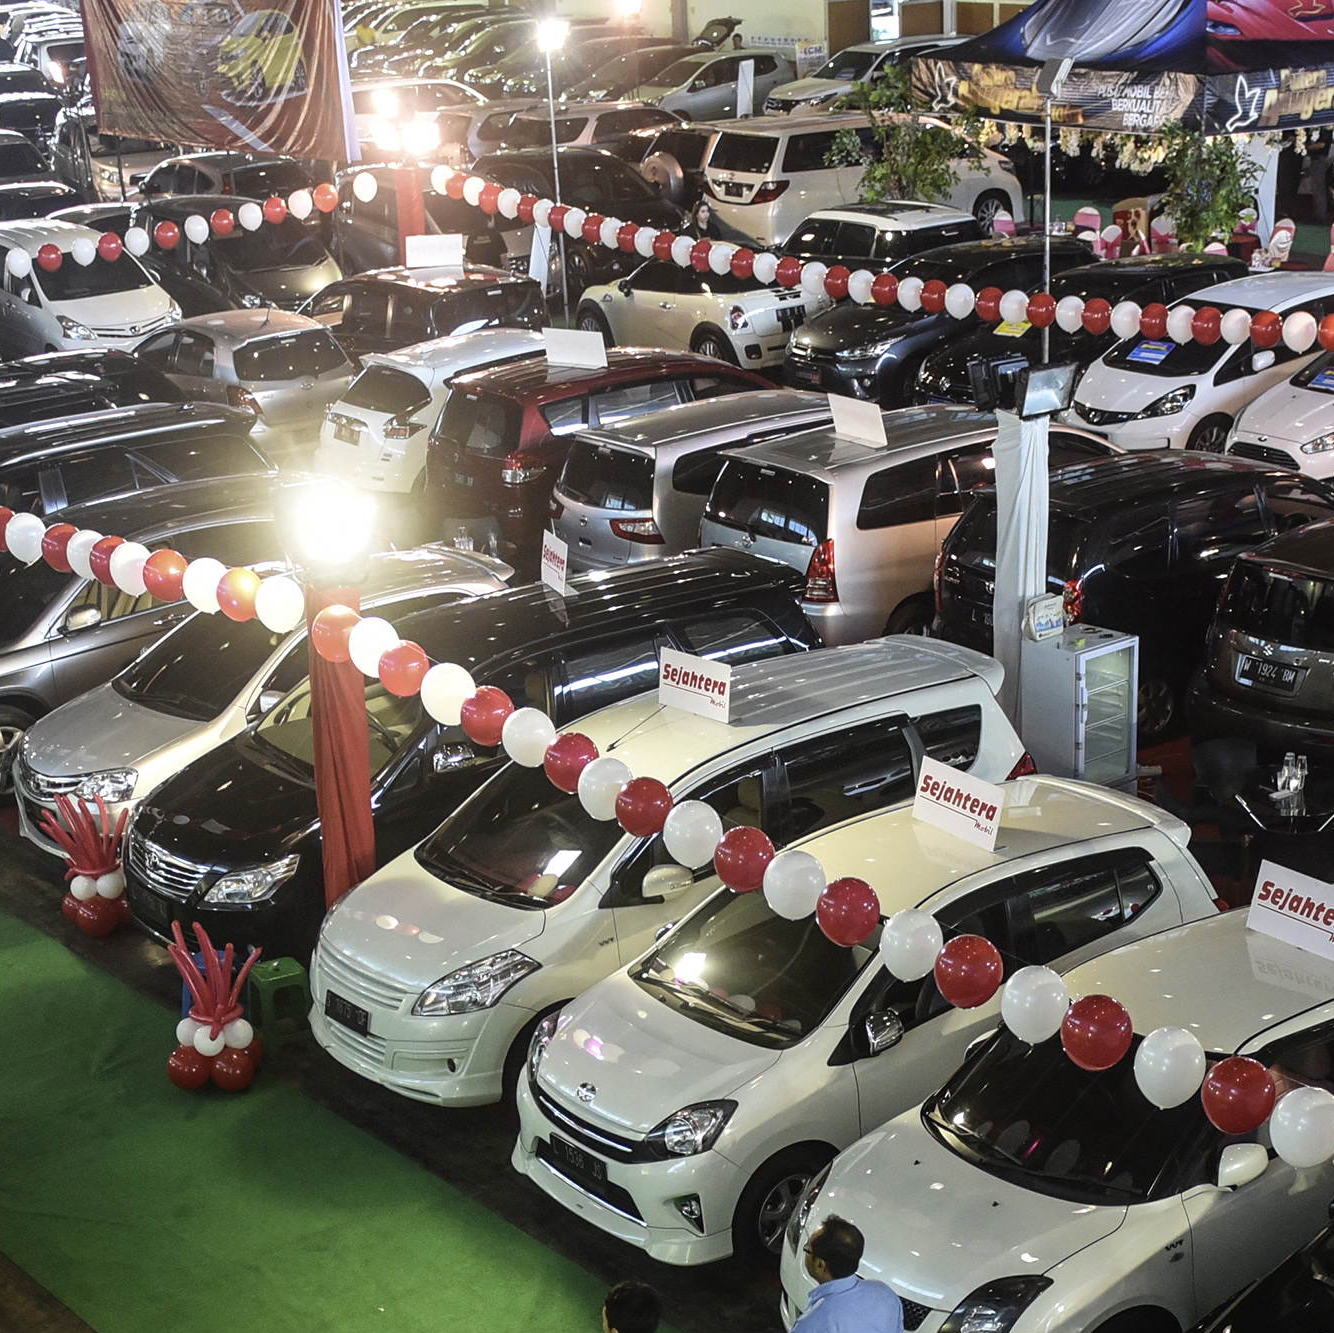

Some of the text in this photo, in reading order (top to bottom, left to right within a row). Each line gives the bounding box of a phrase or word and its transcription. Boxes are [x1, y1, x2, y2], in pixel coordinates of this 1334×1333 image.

[662, 663, 727, 696] Sejahtera
[1257, 662, 1278, 678] 1924
[920, 774, 998, 821] Sejahtera
[974, 820, 994, 836] Mobil
